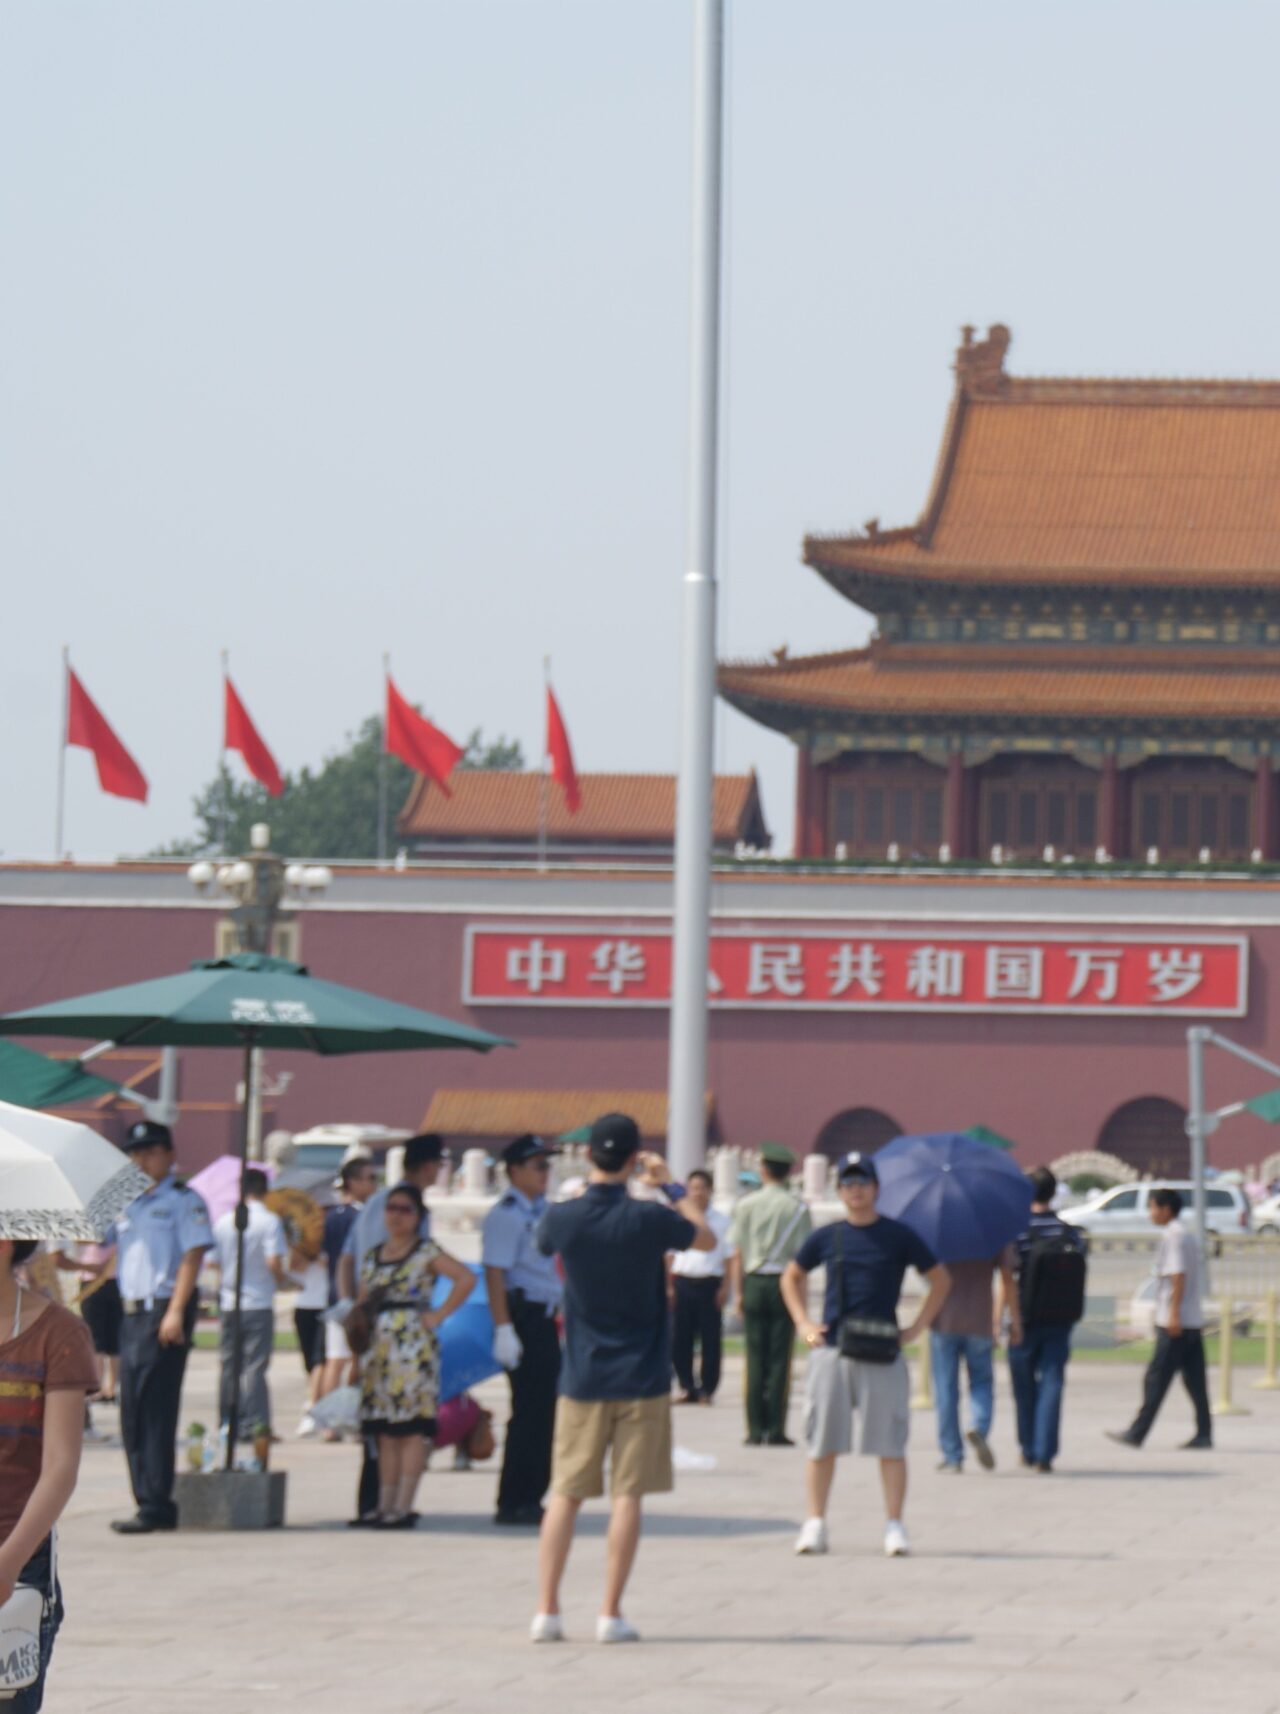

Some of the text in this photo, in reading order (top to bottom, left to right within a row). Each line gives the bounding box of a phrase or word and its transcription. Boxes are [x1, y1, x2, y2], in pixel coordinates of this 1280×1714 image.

[506, 939, 1204, 1001] 中华民共和国万岁
